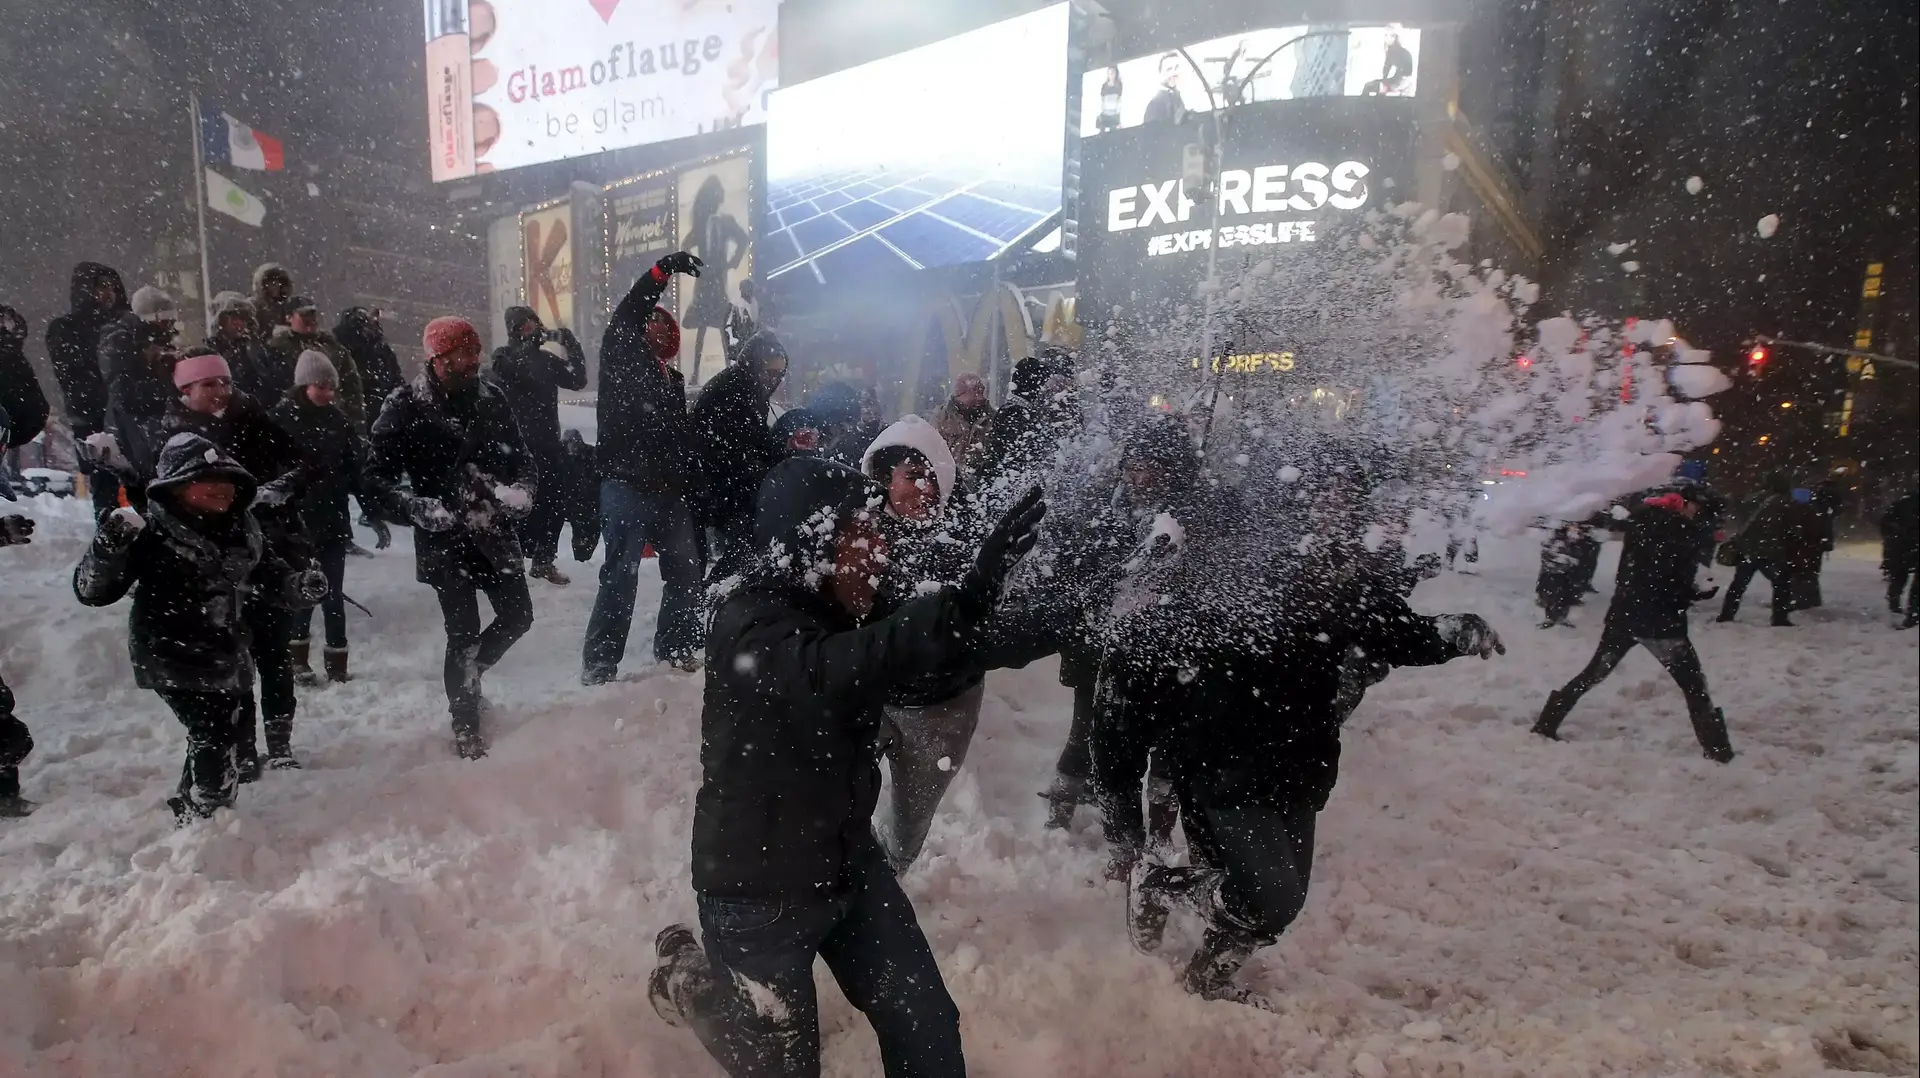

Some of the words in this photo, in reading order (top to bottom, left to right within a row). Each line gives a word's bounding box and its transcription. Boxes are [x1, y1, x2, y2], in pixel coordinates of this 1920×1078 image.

[507, 34, 722, 103] Glamoflauge
[546, 112, 579, 137] be
[593, 97, 675, 134] glam.
[1192, 352, 1294, 374] PRESS
